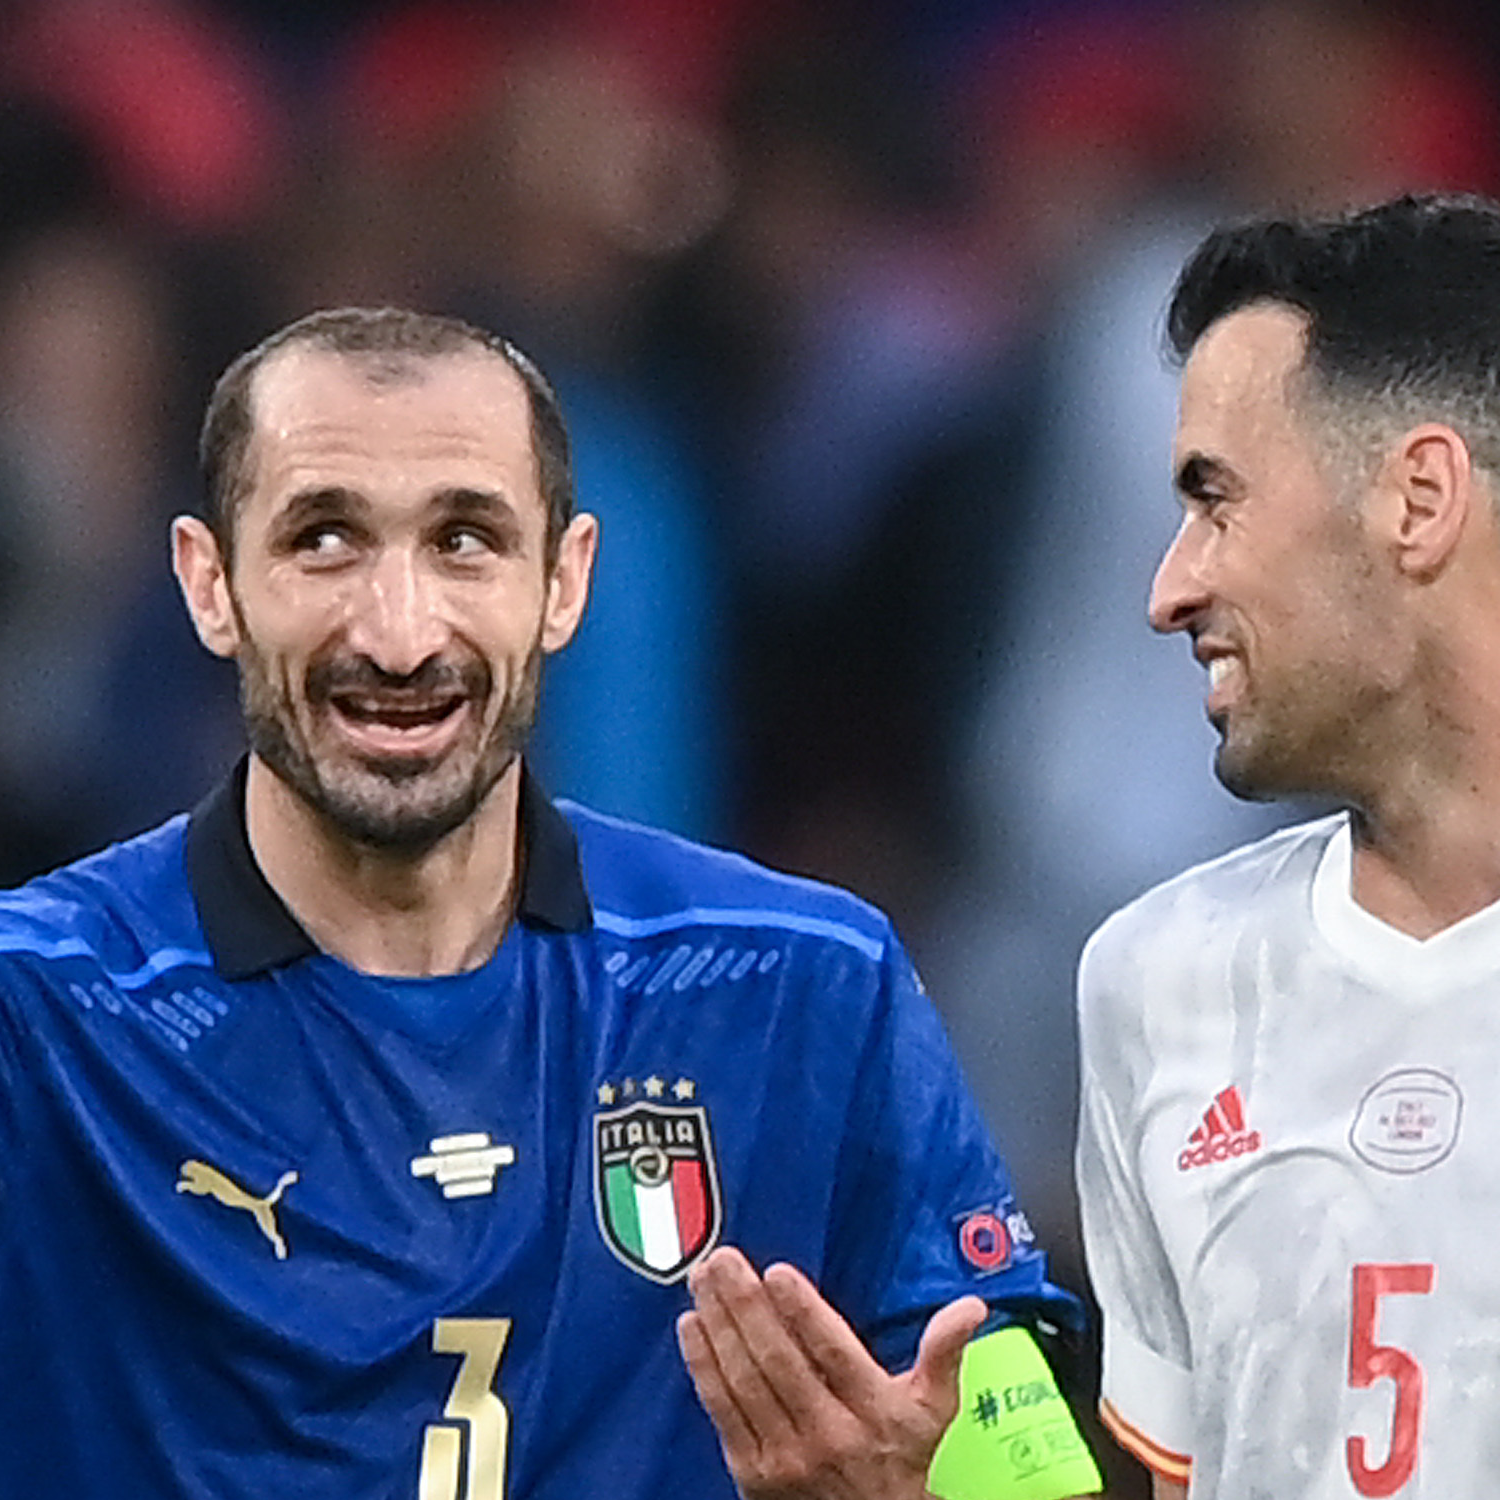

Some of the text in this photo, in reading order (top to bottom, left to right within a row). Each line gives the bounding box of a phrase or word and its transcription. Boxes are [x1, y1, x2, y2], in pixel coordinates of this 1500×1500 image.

[601, 1119, 696, 1151] ITALIA
[1177, 1130, 1260, 1171] adidas
[1346, 1263, 1434, 1499] 5
